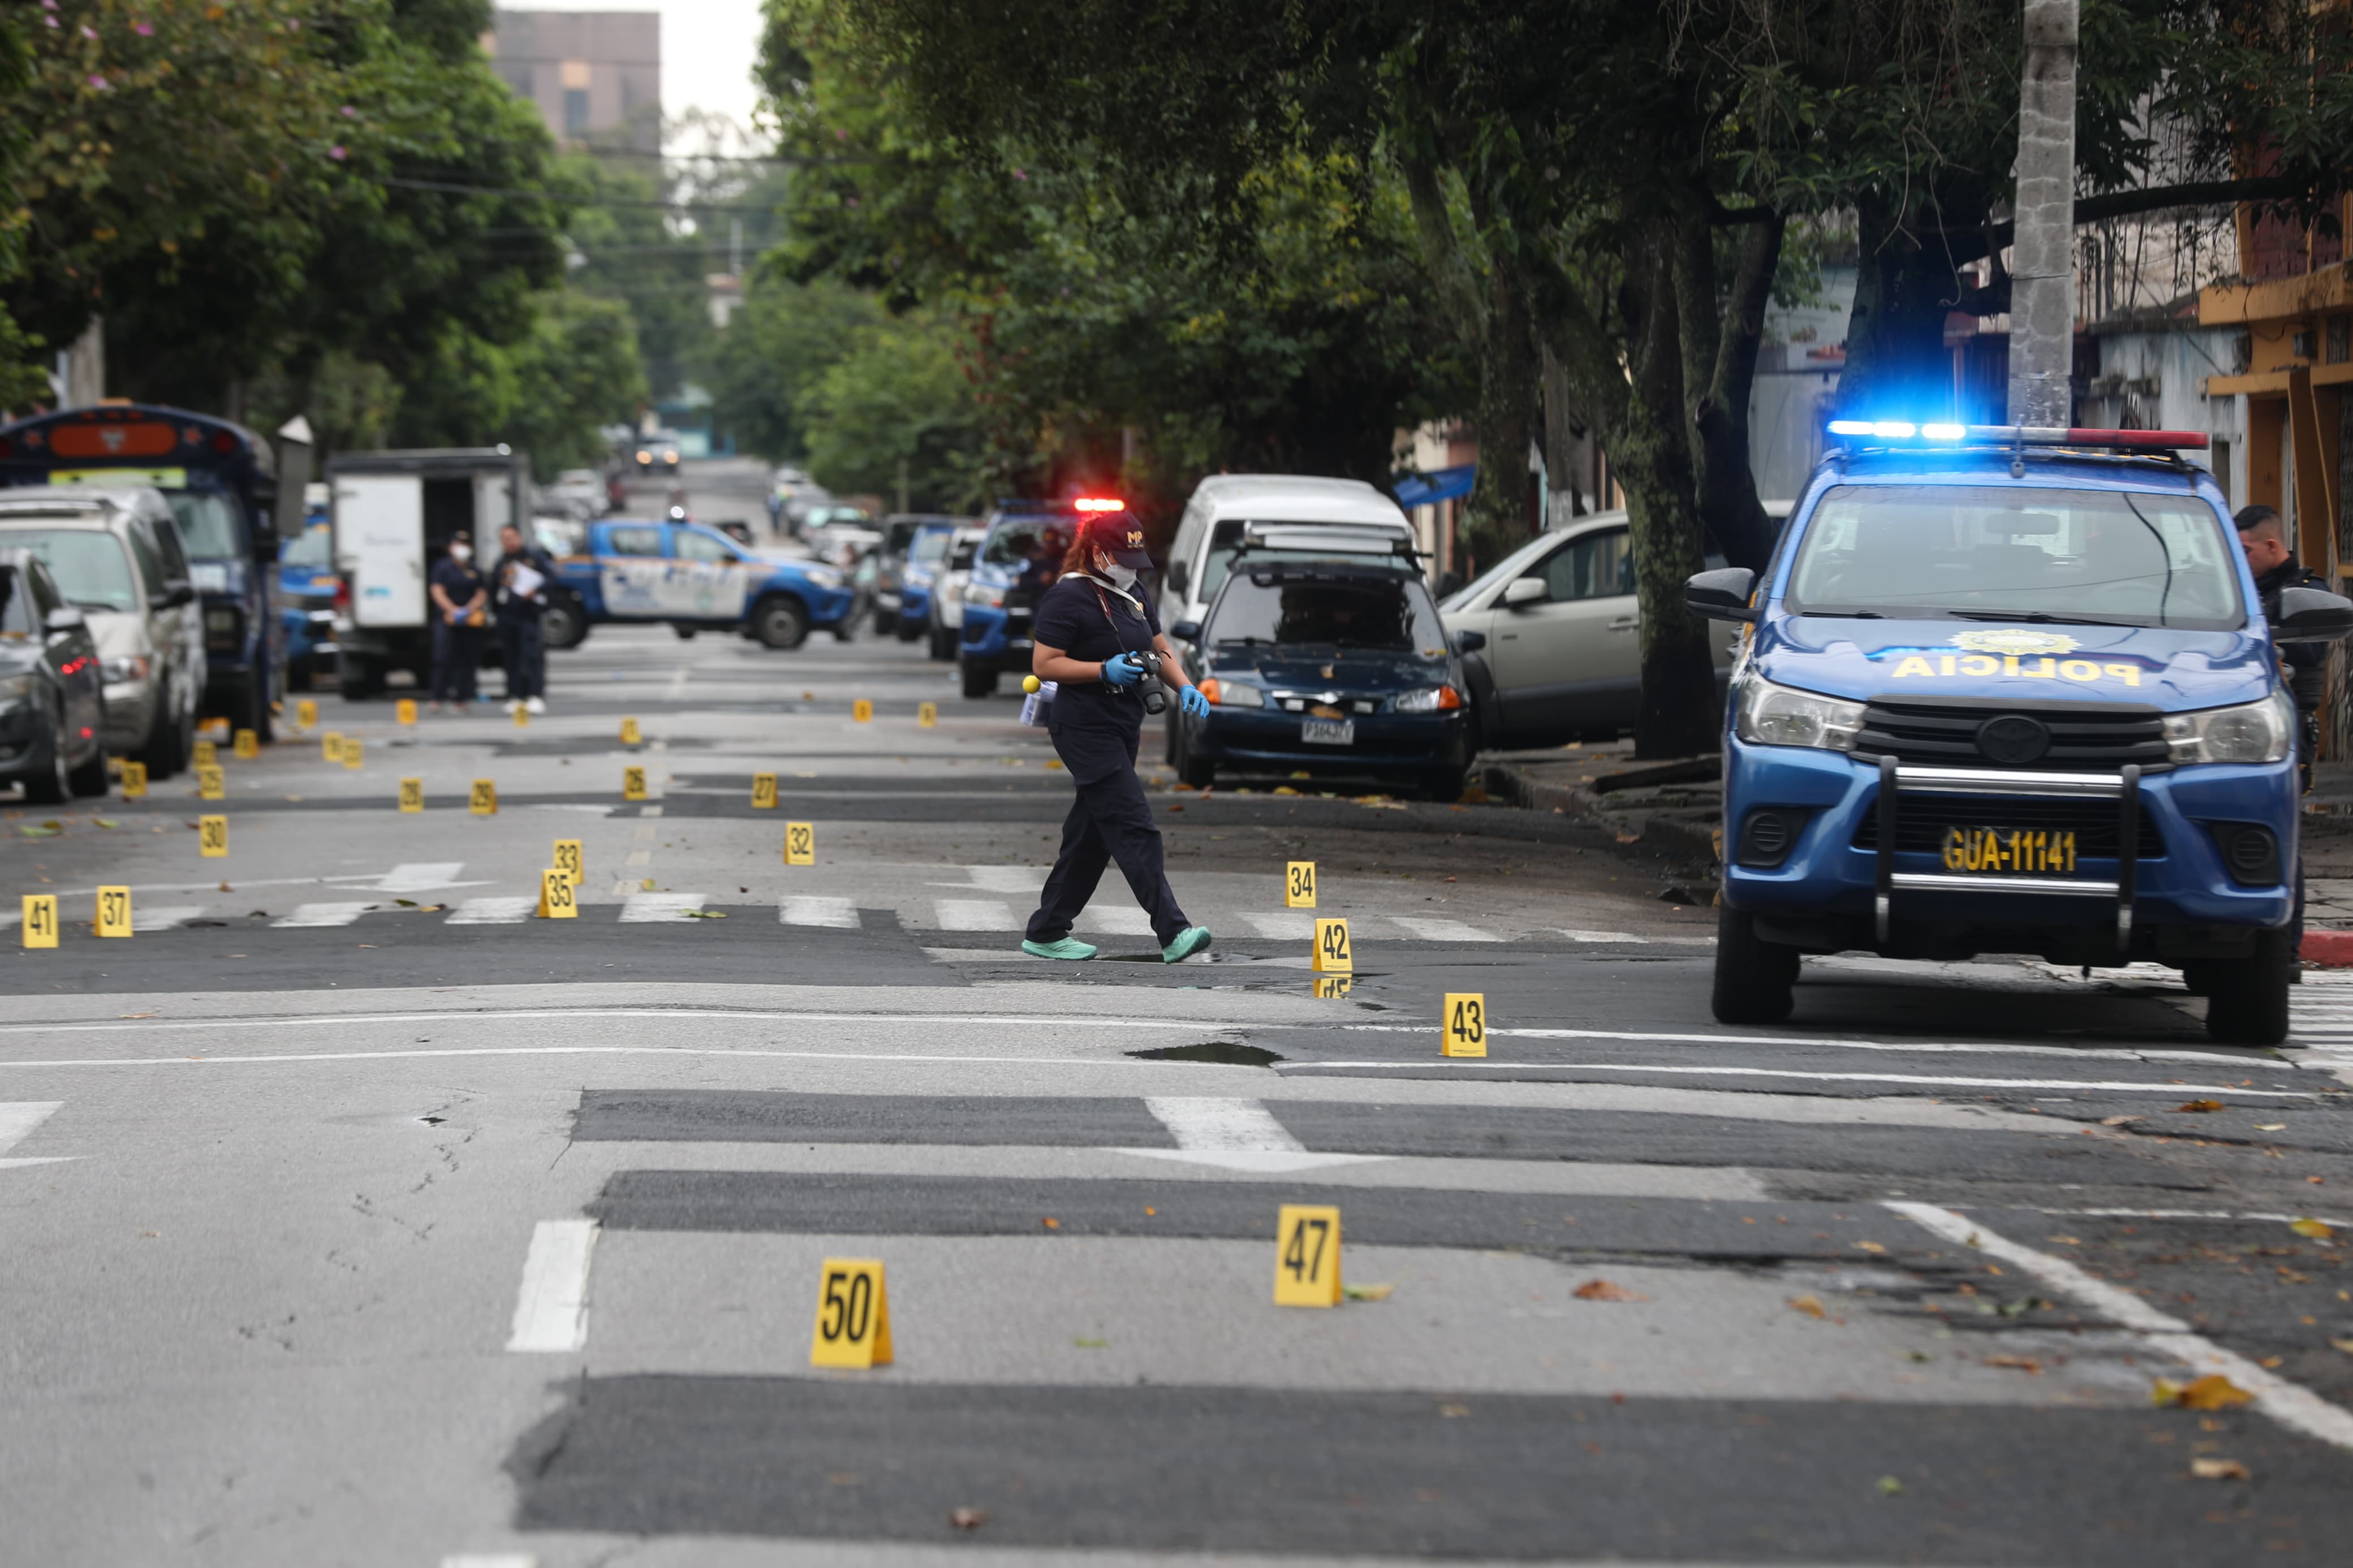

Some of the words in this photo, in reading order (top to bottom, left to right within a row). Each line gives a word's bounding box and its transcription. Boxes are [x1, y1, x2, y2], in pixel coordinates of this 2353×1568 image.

[1127, 530, 1143, 543] MP
[756, 777, 773, 800] 27
[204, 820, 225, 849] 30
[790, 827, 811, 854] 32
[1945, 830, 2075, 871] GUA-11141
[555, 845, 578, 874] 33
[548, 875, 572, 907] 35
[1291, 867, 1313, 897] 34
[30, 901, 51, 935] 41
[103, 892, 126, 926] 37
[1324, 925, 1348, 960] 42
[1453, 1001, 1482, 1043] 43
[1285, 1219, 1329, 1284] 47
[822, 1272, 872, 1342] 50
